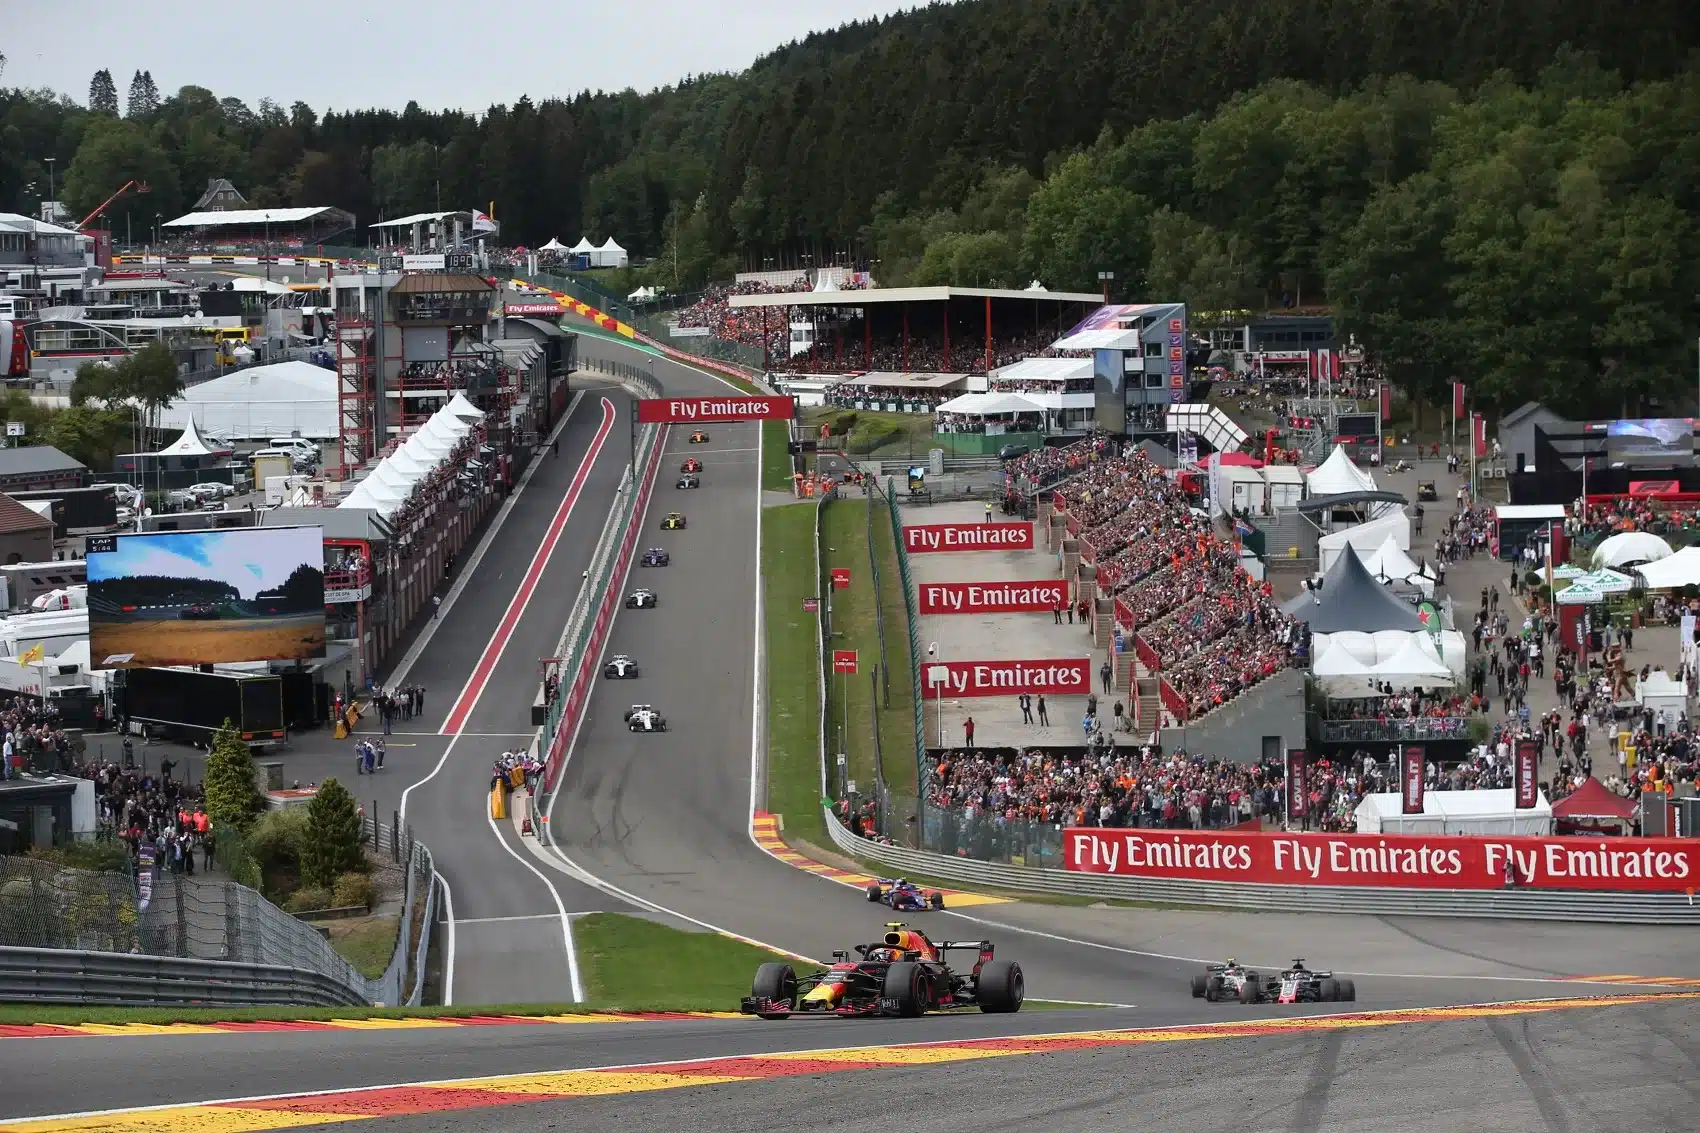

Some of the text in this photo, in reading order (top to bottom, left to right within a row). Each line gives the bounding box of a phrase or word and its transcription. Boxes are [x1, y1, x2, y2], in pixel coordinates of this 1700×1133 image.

[523, 304, 558, 312] Emirates
[670, 399, 770, 419] Fly Emirates
[909, 525, 1027, 549] Fly Emirates
[927, 585, 1061, 610] Fly Emirates
[974, 663, 1082, 687] Emirates
[1522, 756, 1532, 800] LIVE IT
[1294, 778, 1303, 811] LOVE
[1073, 835, 1690, 882] Fly Emirates Fly Emirates Fly Emirates
